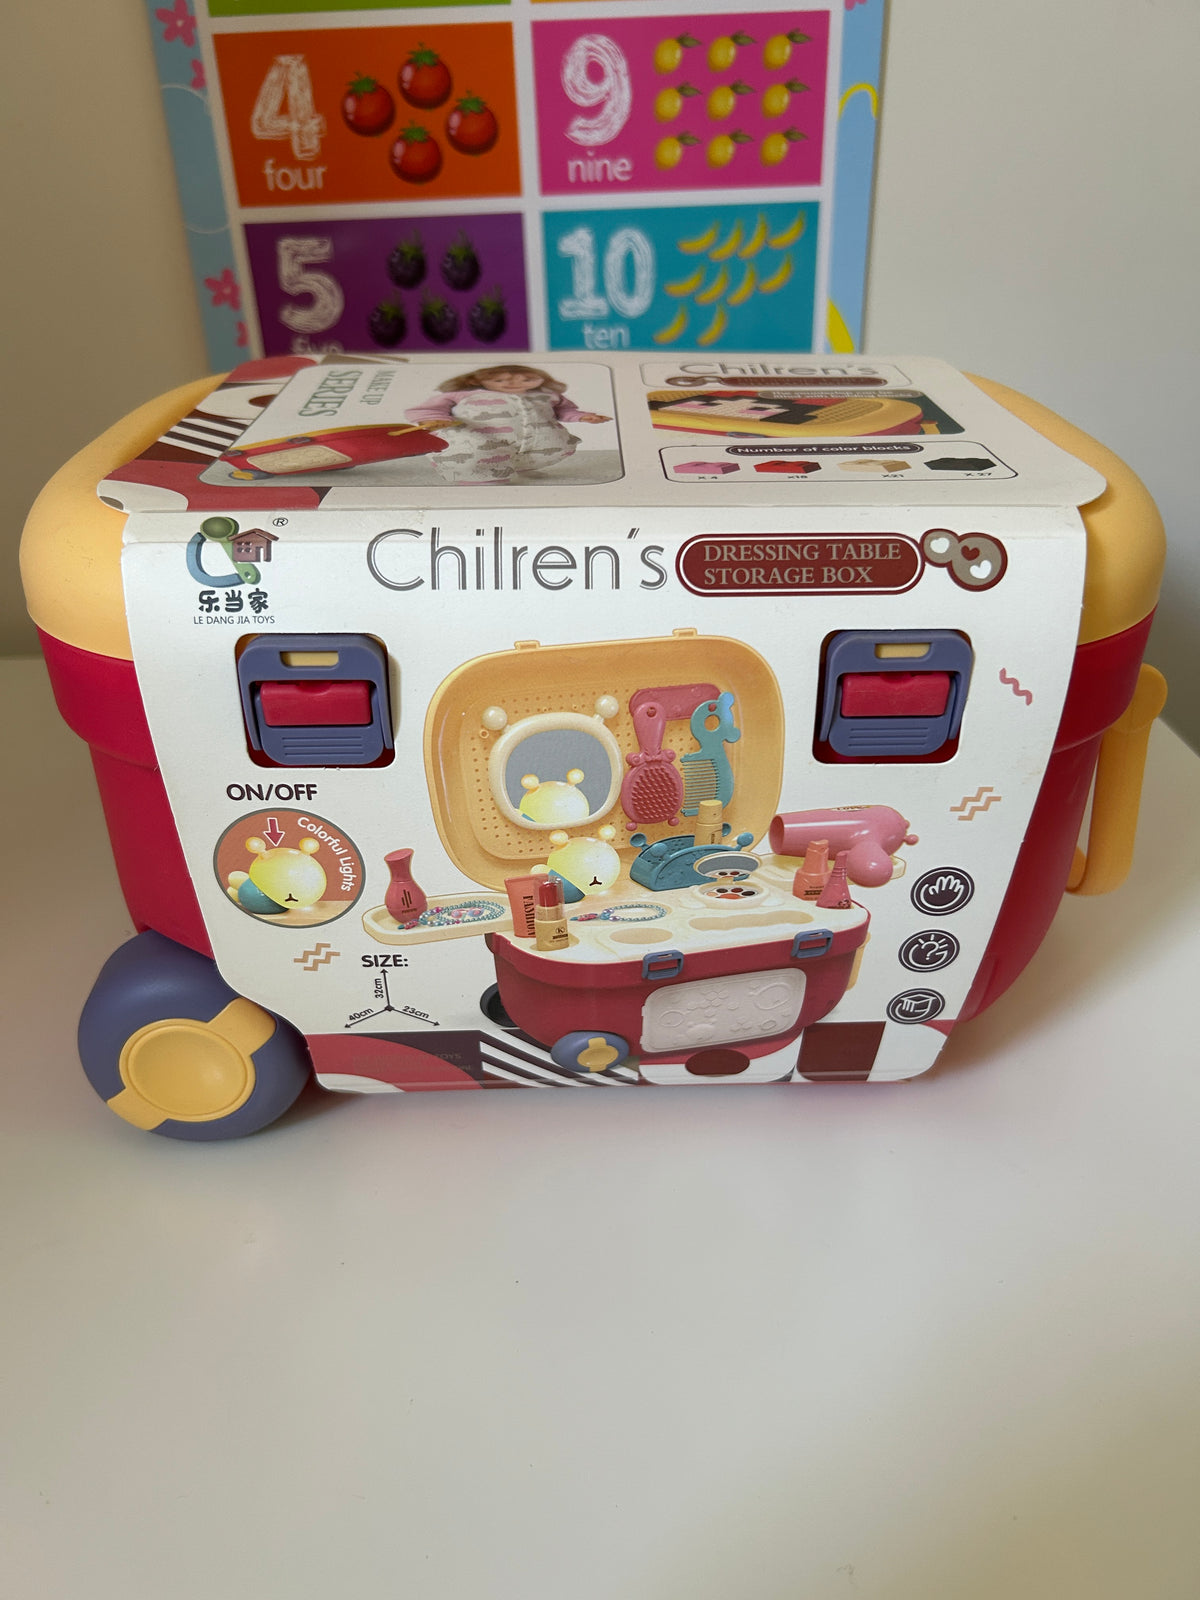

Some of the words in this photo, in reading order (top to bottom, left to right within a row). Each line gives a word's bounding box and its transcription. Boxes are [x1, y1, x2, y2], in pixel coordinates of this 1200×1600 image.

[560, 33, 632, 147] 9
[250, 53, 327, 161] 4
[262, 157, 328, 191] four
[567, 150, 633, 183] nine
[558, 225, 657, 320] 10
[277, 236, 345, 334] 5
[582, 320, 631, 350] ten
[679, 362, 879, 376] Chilren's
[298, 370, 363, 416] SERIES
[366, 371, 397, 392] MAKE
[360, 394, 385, 405] UP
[366, 526, 667, 591] Chilren's
[703, 544, 820, 562] DRESSING
[826, 543, 901, 560] TABLE
[704, 567, 815, 585] STORAGE
[821, 566, 873, 583] BOX
[198, 588, 269, 614] 乐当家
[193, 616, 204, 624] LE
[206, 616, 234, 624] DANG
[237, 616, 250, 624] JIA
[252, 616, 275, 624] TOYS
[226, 783, 318, 801] ON/OFF
[297, 817, 348, 855] Colorful
[339, 856, 357, 891] Lights
[361, 954, 409, 968] SIZE:
[374, 978, 384, 999] 32cm
[348, 1008, 375, 1021] 40cm
[402, 1005, 430, 1019] 23cm
